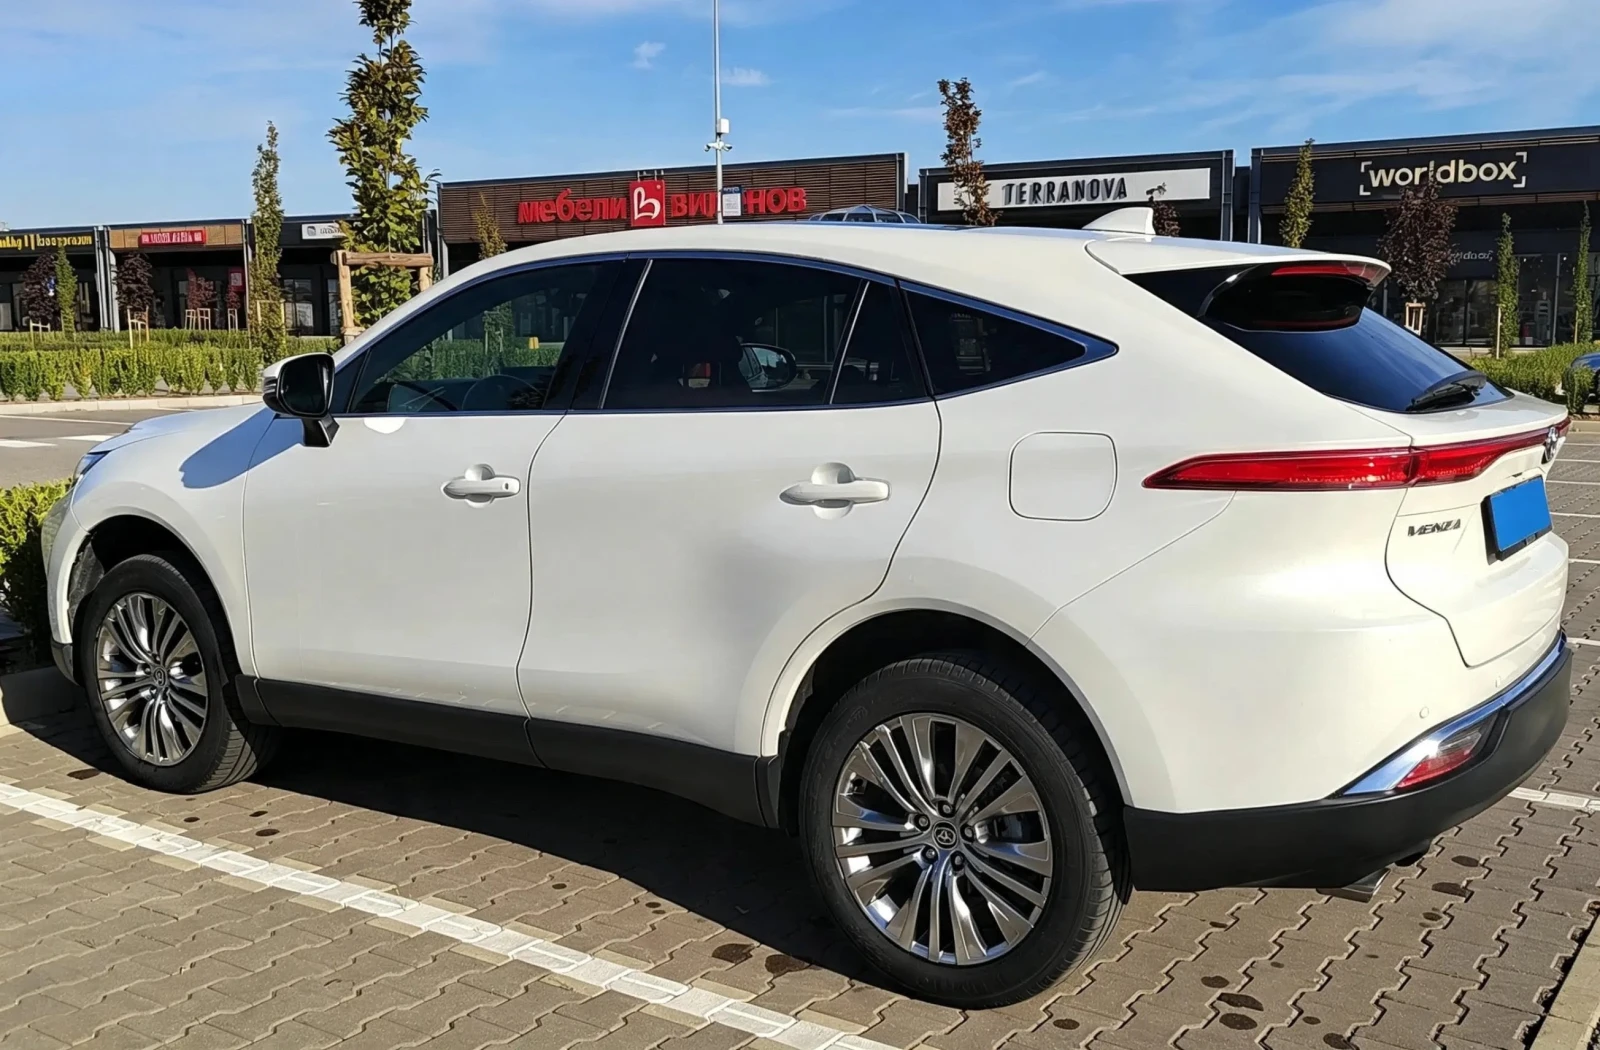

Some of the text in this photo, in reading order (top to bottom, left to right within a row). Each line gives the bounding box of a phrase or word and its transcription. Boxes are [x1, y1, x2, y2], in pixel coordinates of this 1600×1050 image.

[1369, 159, 1517, 187] worldbox
[1002, 177, 1127, 205] TERRANOVA
[1408, 518, 1461, 537] VENZA
